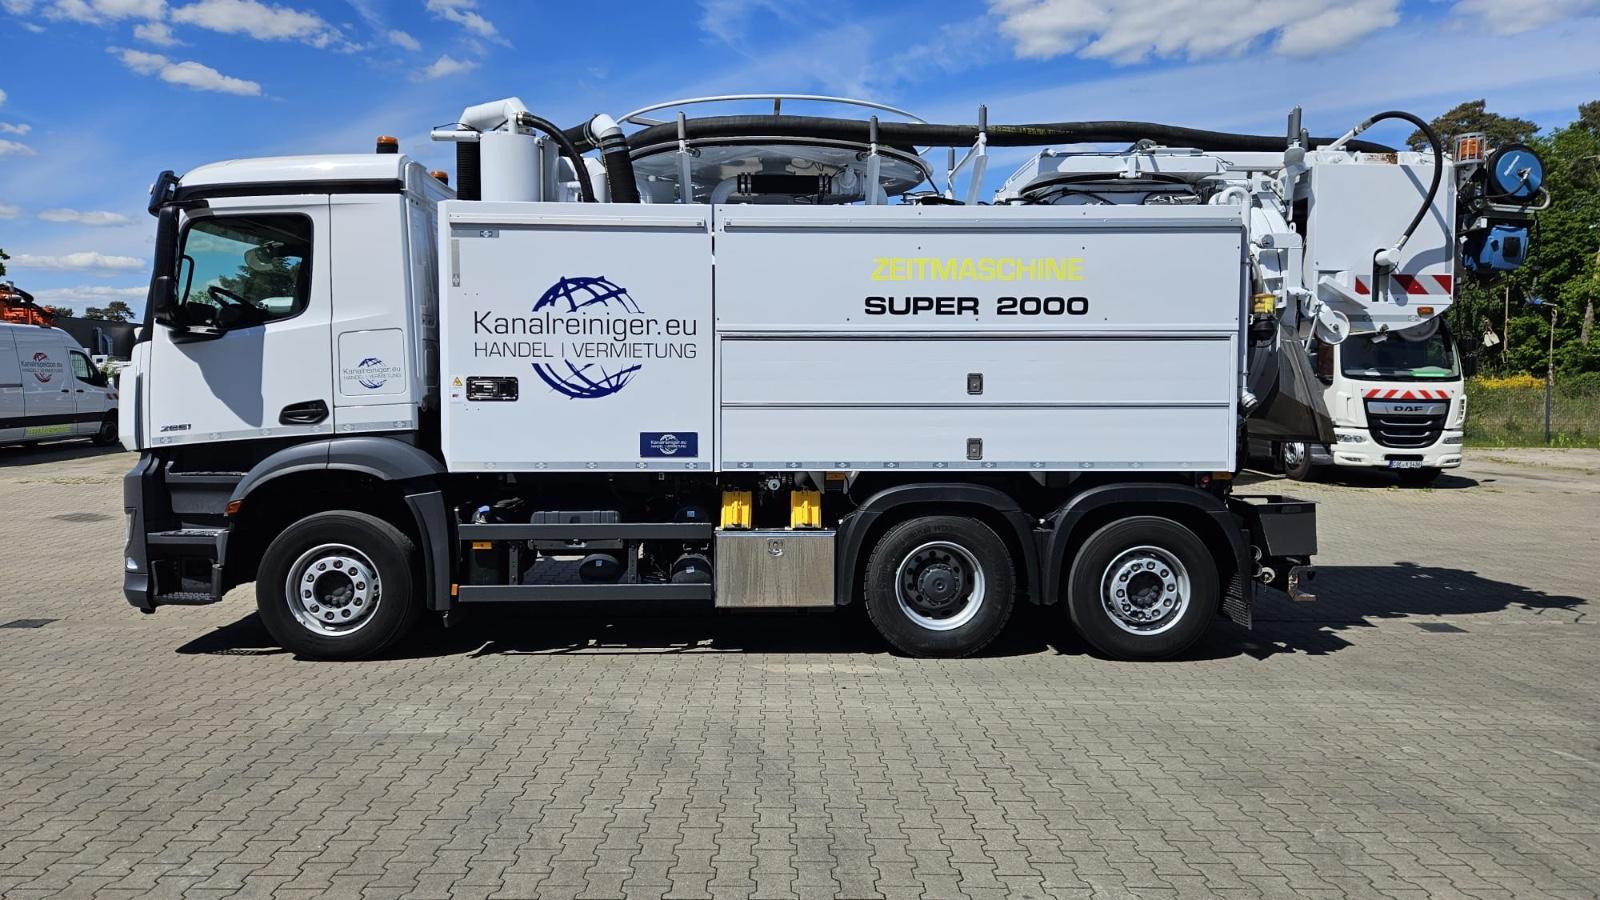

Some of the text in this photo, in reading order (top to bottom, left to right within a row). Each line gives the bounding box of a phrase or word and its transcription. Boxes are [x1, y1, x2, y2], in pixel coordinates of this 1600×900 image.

[871, 257, 1085, 281] ZEITMASCHINE
[864, 296, 1089, 316] SUPER 2000
[474, 311, 697, 342] Kanalreiniger.eu
[474, 342, 554, 358] HANDEL
[572, 343, 697, 359] VERMIETUNG
